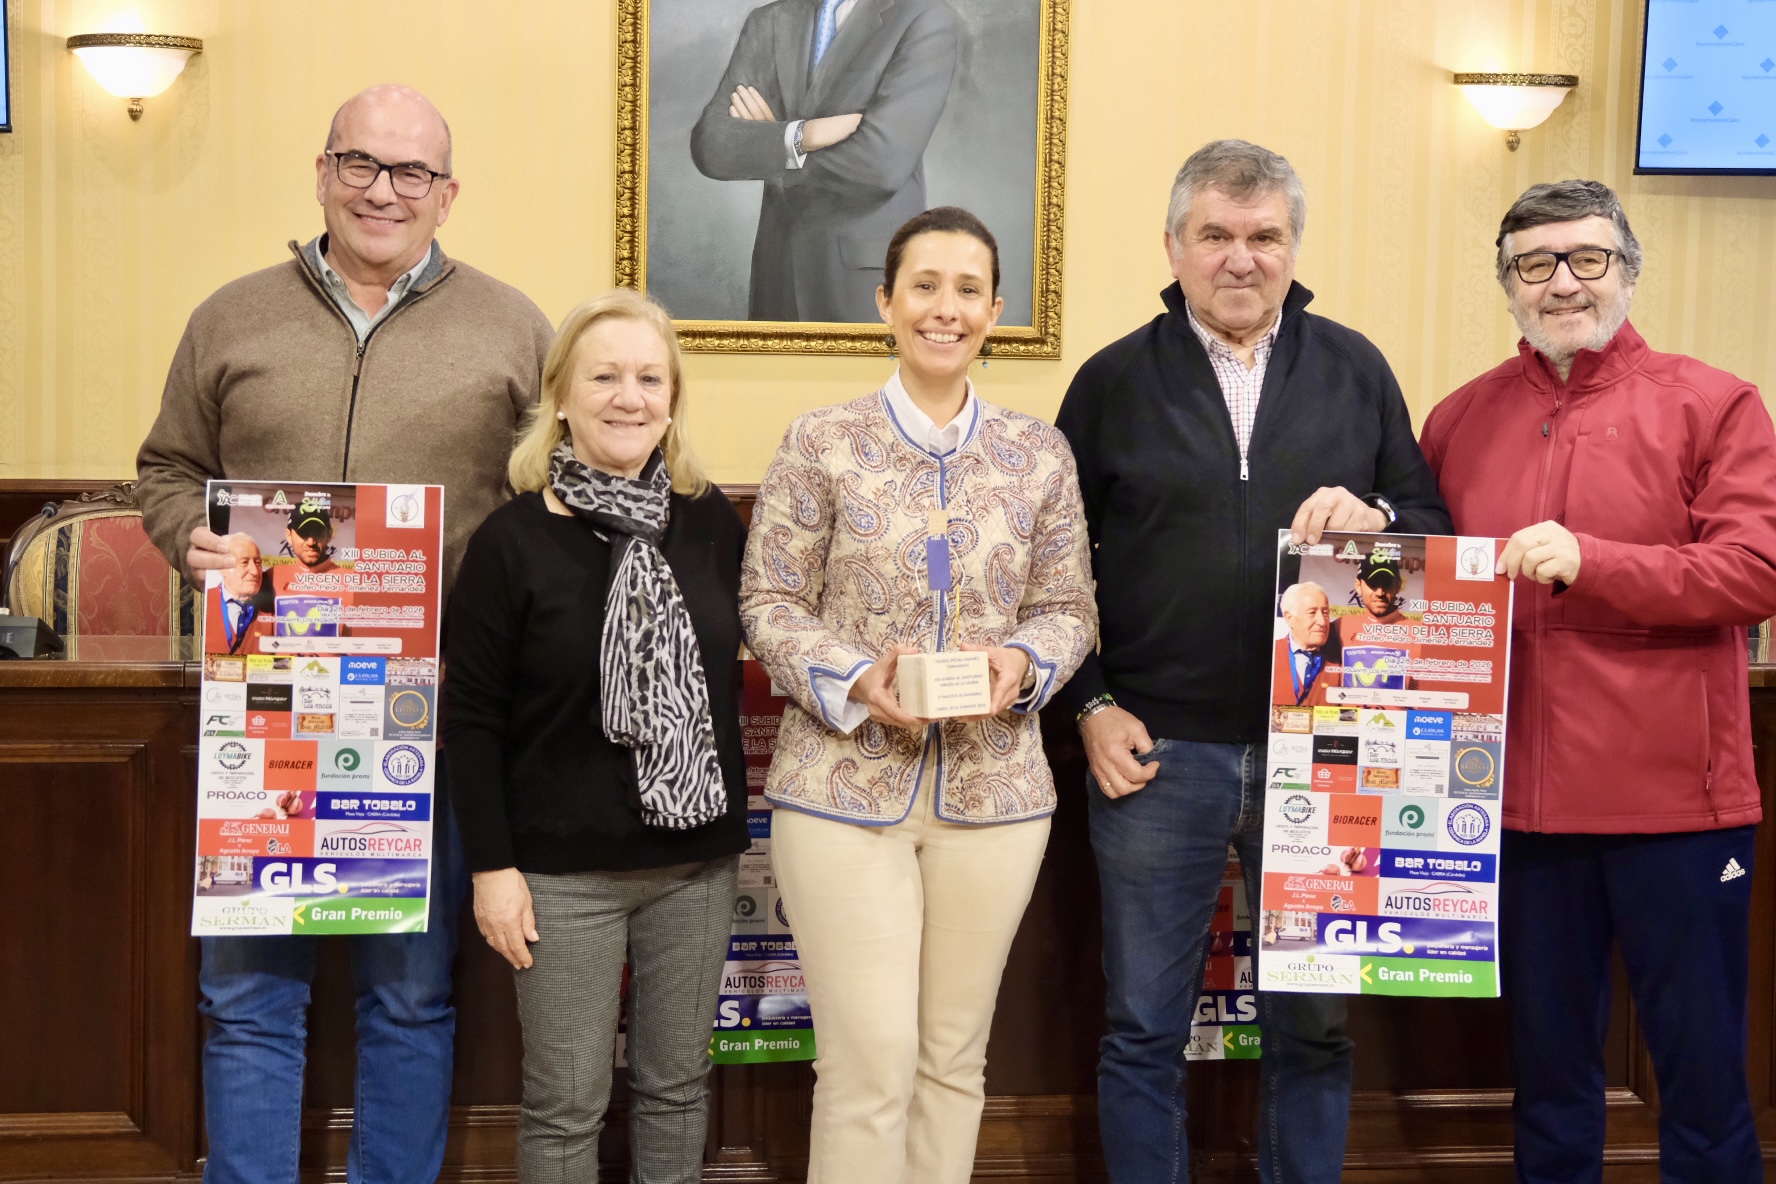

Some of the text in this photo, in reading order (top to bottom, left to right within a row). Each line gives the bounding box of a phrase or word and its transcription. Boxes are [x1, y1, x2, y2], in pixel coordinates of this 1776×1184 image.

[343, 549, 426, 560] XIII SUBIDA AL
[356, 562, 425, 572] SANTUARIO
[296, 574, 425, 585] VIRGEN DE LA SIERRA
[1411, 600, 1494, 613] XIII SUBIDA AL
[1424, 614, 1494, 625] SANTUARIO
[1364, 625, 1492, 638] VIRGEN DE LA SIERRA
[751, 716, 781, 725] SUBID
[1414, 716, 1443, 724] moeve
[745, 728, 780, 736] SANTU
[752, 740, 766, 748] LA
[269, 760, 313, 769] BIORACER
[207, 791, 267, 800] PROACO
[1279, 805, 1316, 814] LUYMABIKE
[1333, 815, 1377, 826] BIORACER
[242, 824, 289, 834] GENERALI
[321, 838, 422, 851] AUTOSREYCAR
[1272, 844, 1331, 855] PROACO
[1721, 868, 1745, 882] adidas
[1306, 880, 1353, 891] GENERALI
[1385, 896, 1488, 914] AUTOSREYCAR
[312, 907, 402, 920] Gran Premio
[201, 916, 286, 926] SERMAN
[1288, 963, 1333, 972] GRUPO
[1268, 971, 1352, 984] SERMAN
[1379, 967, 1473, 983] Gran Premio
[725, 976, 805, 988] AUTOSREYCA
[720, 1038, 800, 1051] Gran Premio
[1239, 1034, 1260, 1045] Gra
